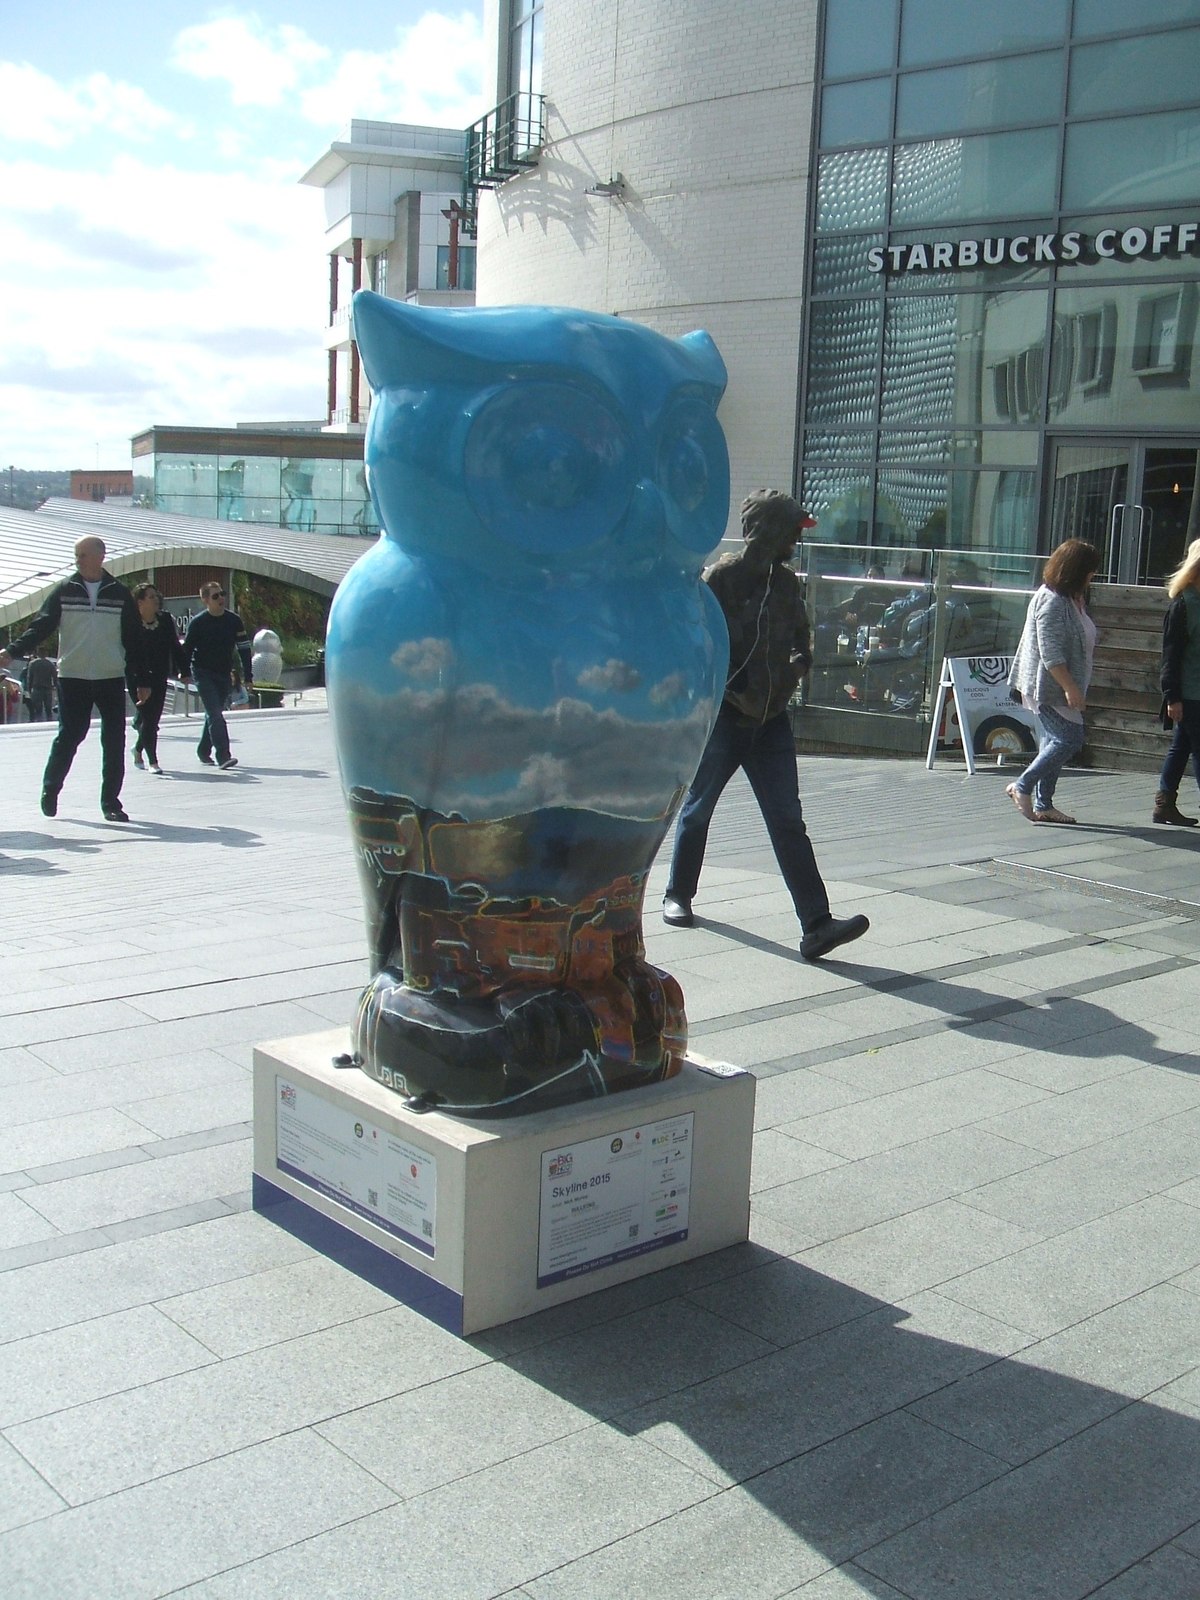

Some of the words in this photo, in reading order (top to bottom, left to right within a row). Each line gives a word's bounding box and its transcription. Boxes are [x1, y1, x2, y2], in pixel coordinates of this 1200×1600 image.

[867, 231, 1081, 273] STARBUCKS
[552, 1180, 588, 1199] Skyline
[590, 1173, 611, 1188] 2015
